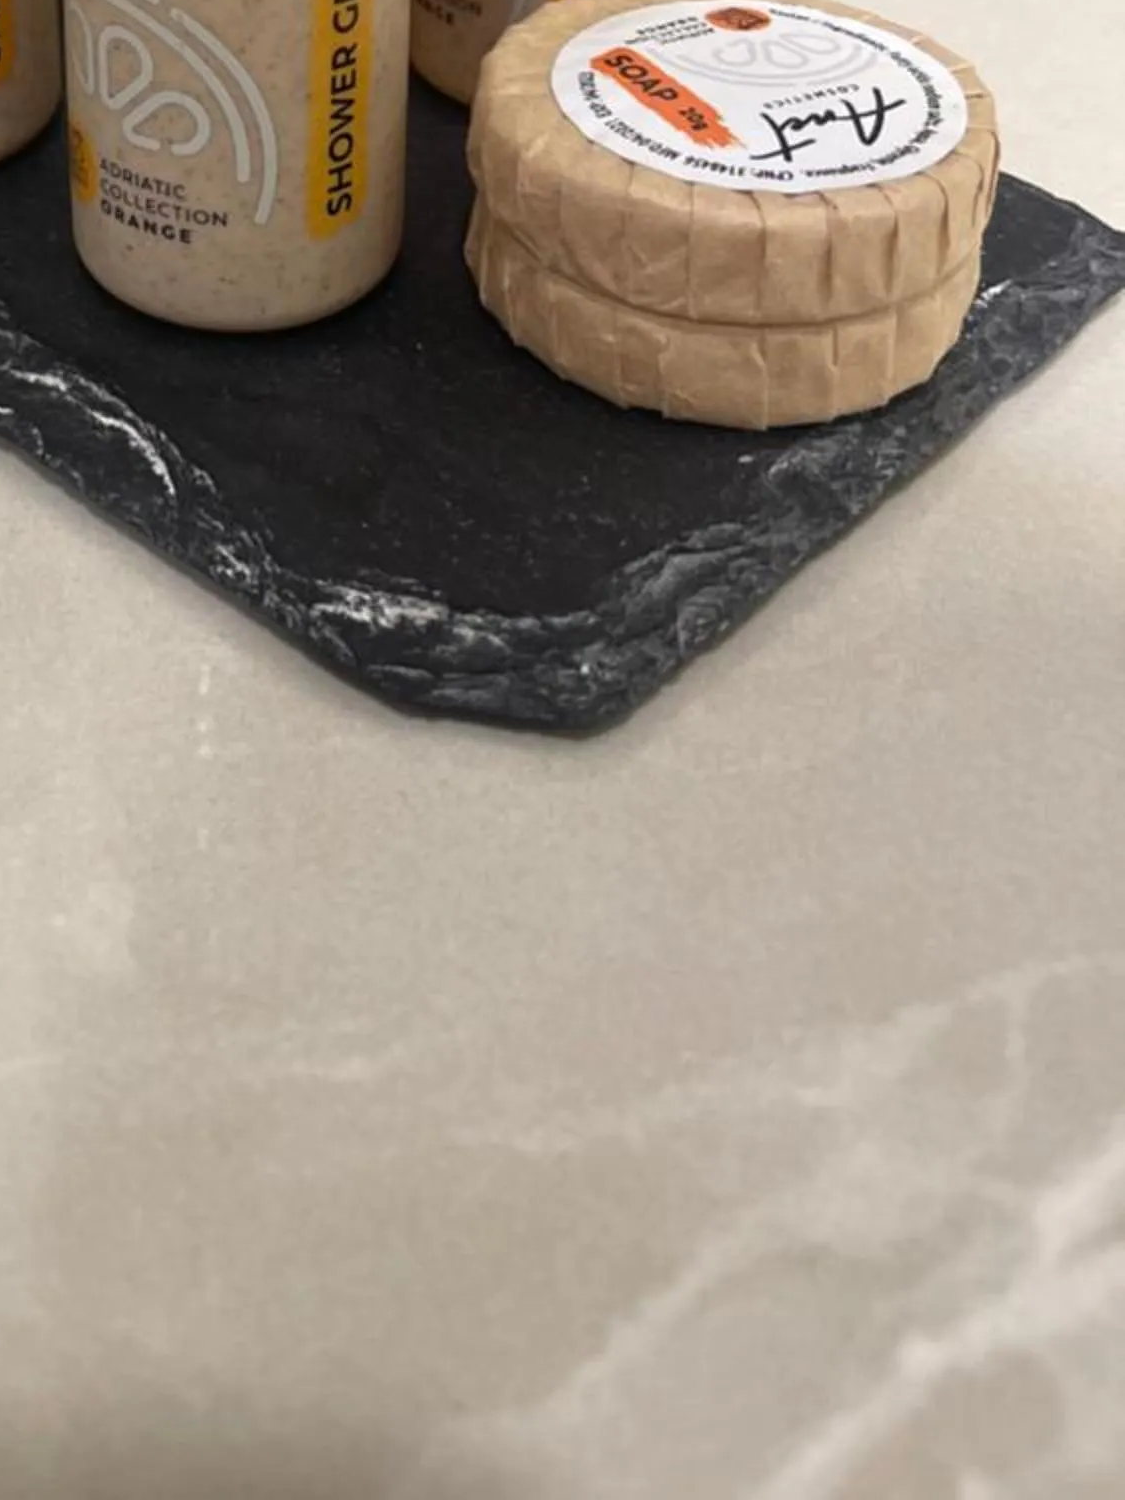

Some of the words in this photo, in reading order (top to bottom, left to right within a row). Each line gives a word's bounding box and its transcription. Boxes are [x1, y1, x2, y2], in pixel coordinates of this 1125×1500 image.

[604, 52, 680, 103] SOAP
[326, 43, 358, 217] SHOWER
[750, 86, 907, 164] Anet
[99, 157, 186, 200] ADRIATIC
[100, 177, 229, 228] COLLECTION
[100, 199, 193, 244] ORANGE
